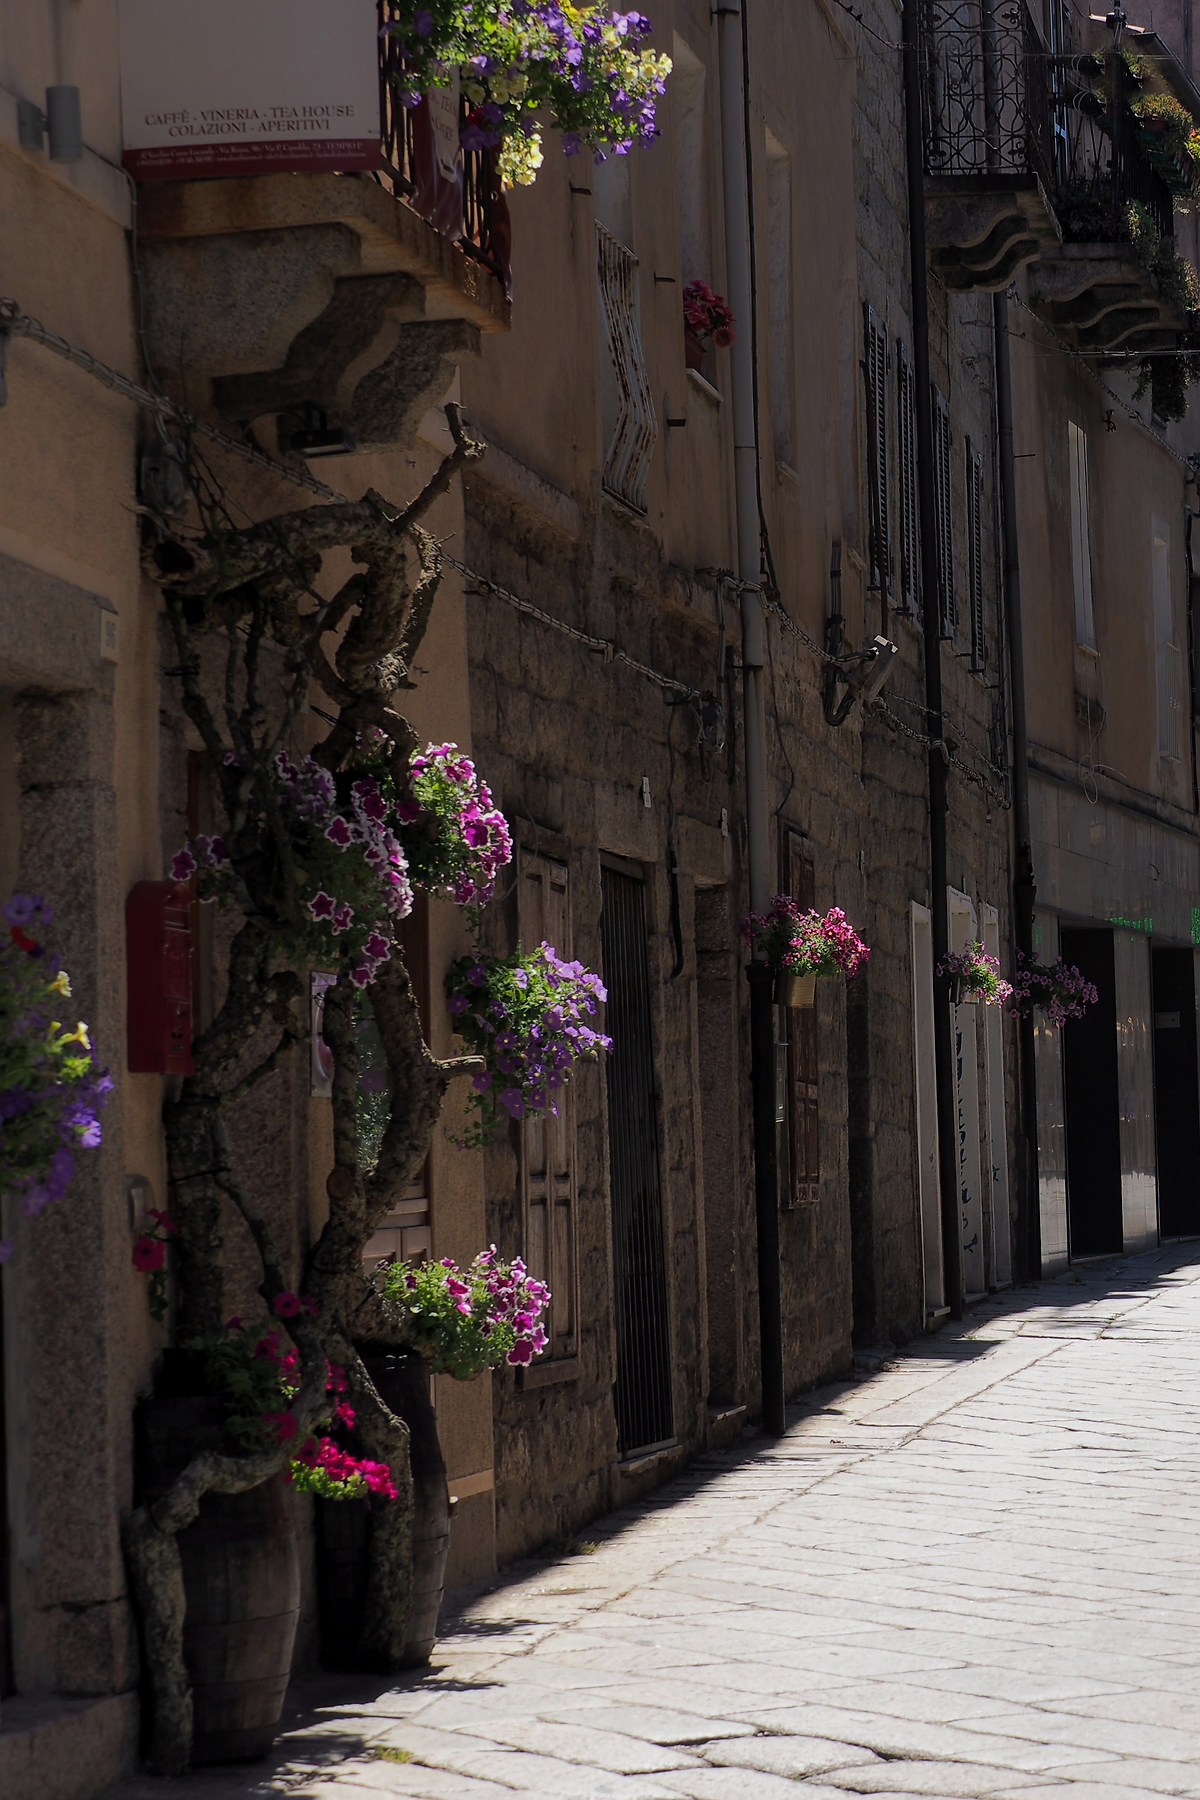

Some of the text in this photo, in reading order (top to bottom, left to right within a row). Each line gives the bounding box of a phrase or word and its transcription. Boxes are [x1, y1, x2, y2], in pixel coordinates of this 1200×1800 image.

[145, 104, 354, 126] CAFFÈ VINERIA TEA HOUSE
[169, 119, 330, 137] COLAZIONI APERITIVI
